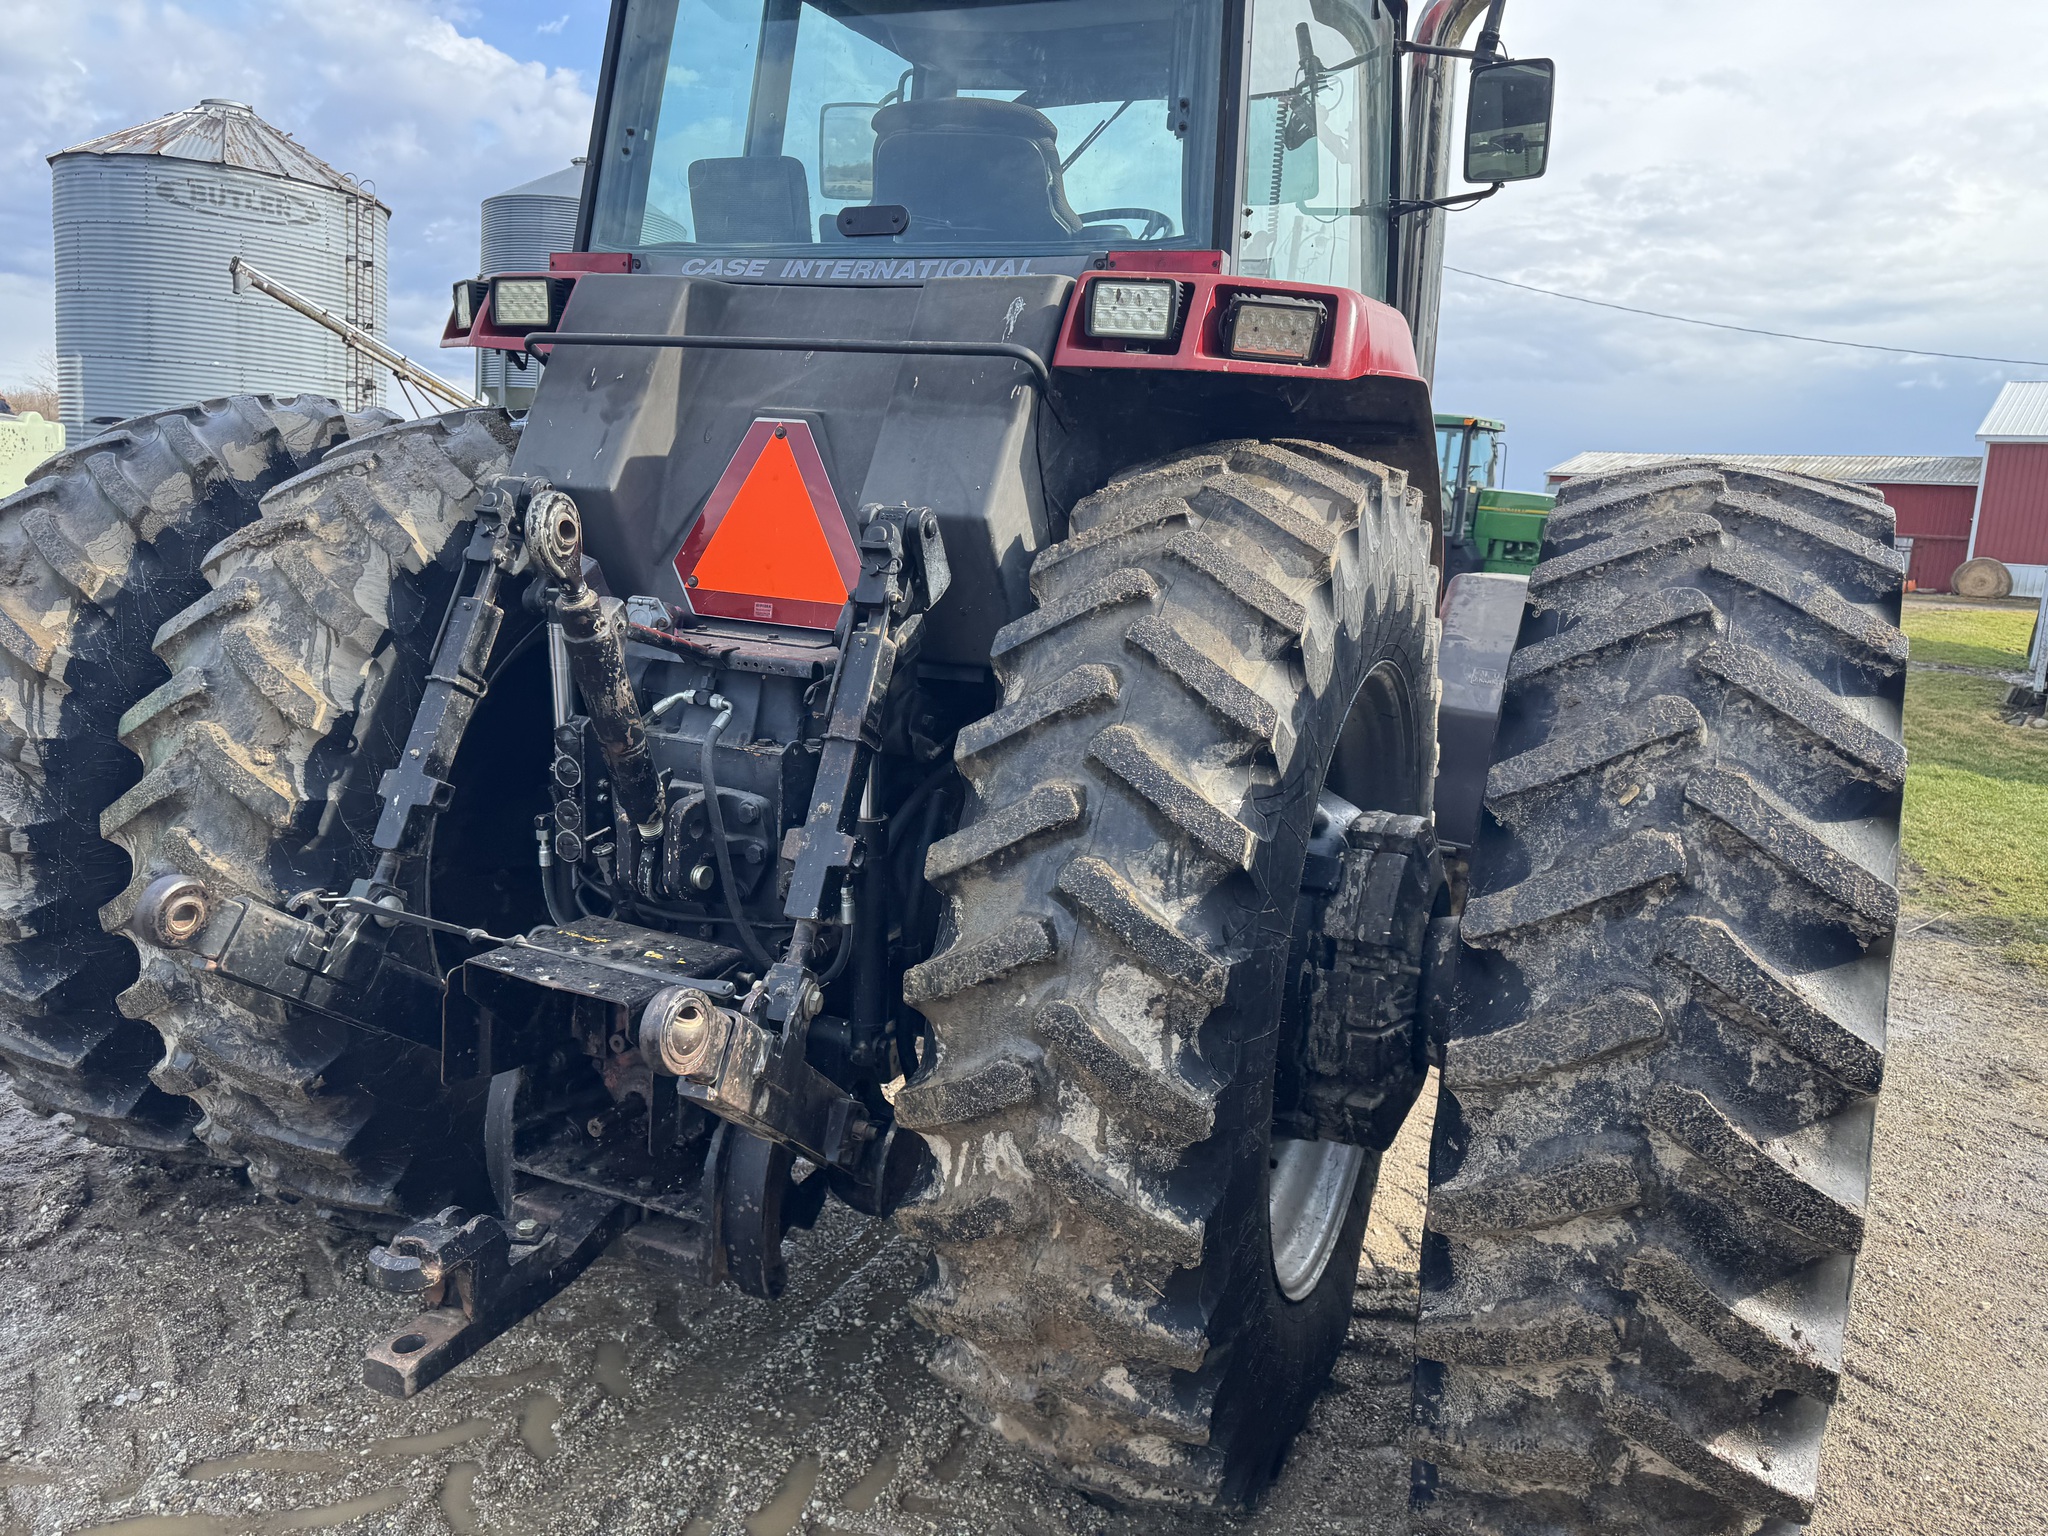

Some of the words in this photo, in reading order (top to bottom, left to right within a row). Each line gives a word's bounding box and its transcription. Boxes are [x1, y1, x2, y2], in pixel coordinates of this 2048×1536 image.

[190, 184, 292, 217] BUTLER
[681, 258, 770, 277] CASE
[780, 258, 1035, 279] INTERNATIONAL
